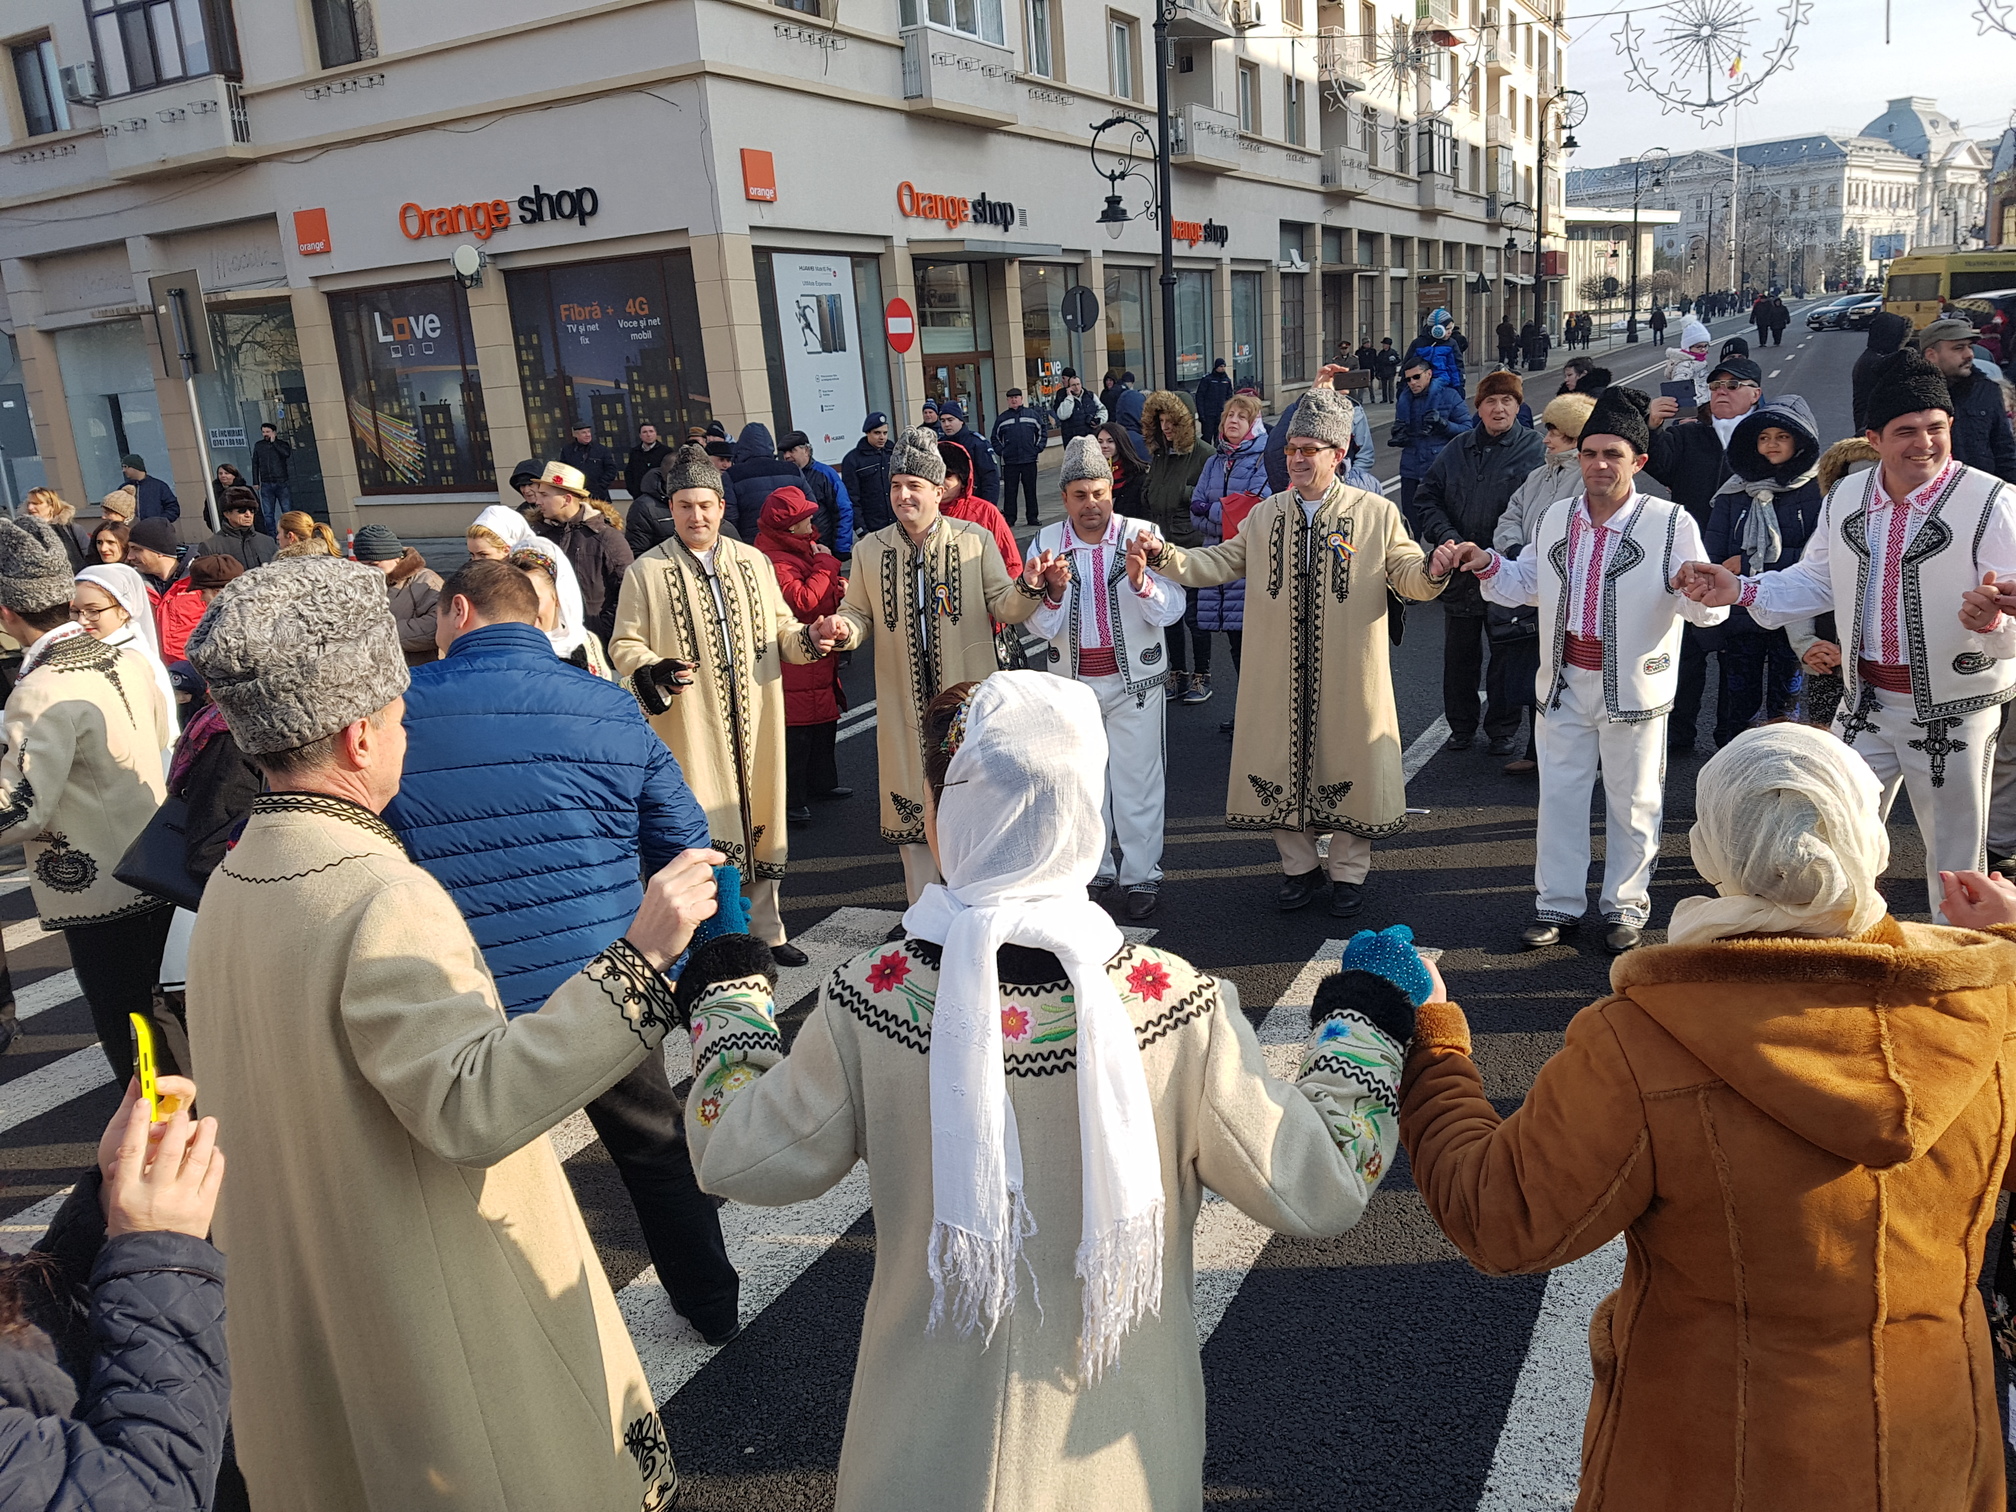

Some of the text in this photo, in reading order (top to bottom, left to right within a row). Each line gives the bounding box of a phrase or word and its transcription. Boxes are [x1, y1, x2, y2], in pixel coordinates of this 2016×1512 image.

[750, 187, 775, 199] orange
[399, 184, 599, 240] Orange shop
[897, 180, 1015, 232] Orange shop
[1203, 218, 1229, 248] shop
[299, 241, 325, 252] orange
[560, 301, 602, 322] Fibră
[625, 296, 650, 316] 4G
[374, 311, 441, 343] Love
[567, 324, 577, 333] TV
[587, 322, 600, 332] net
[618, 319, 638, 328] Voce
[648, 317, 661, 327] net
[580, 335, 590, 345] fix
[630, 330, 653, 340] mobil
